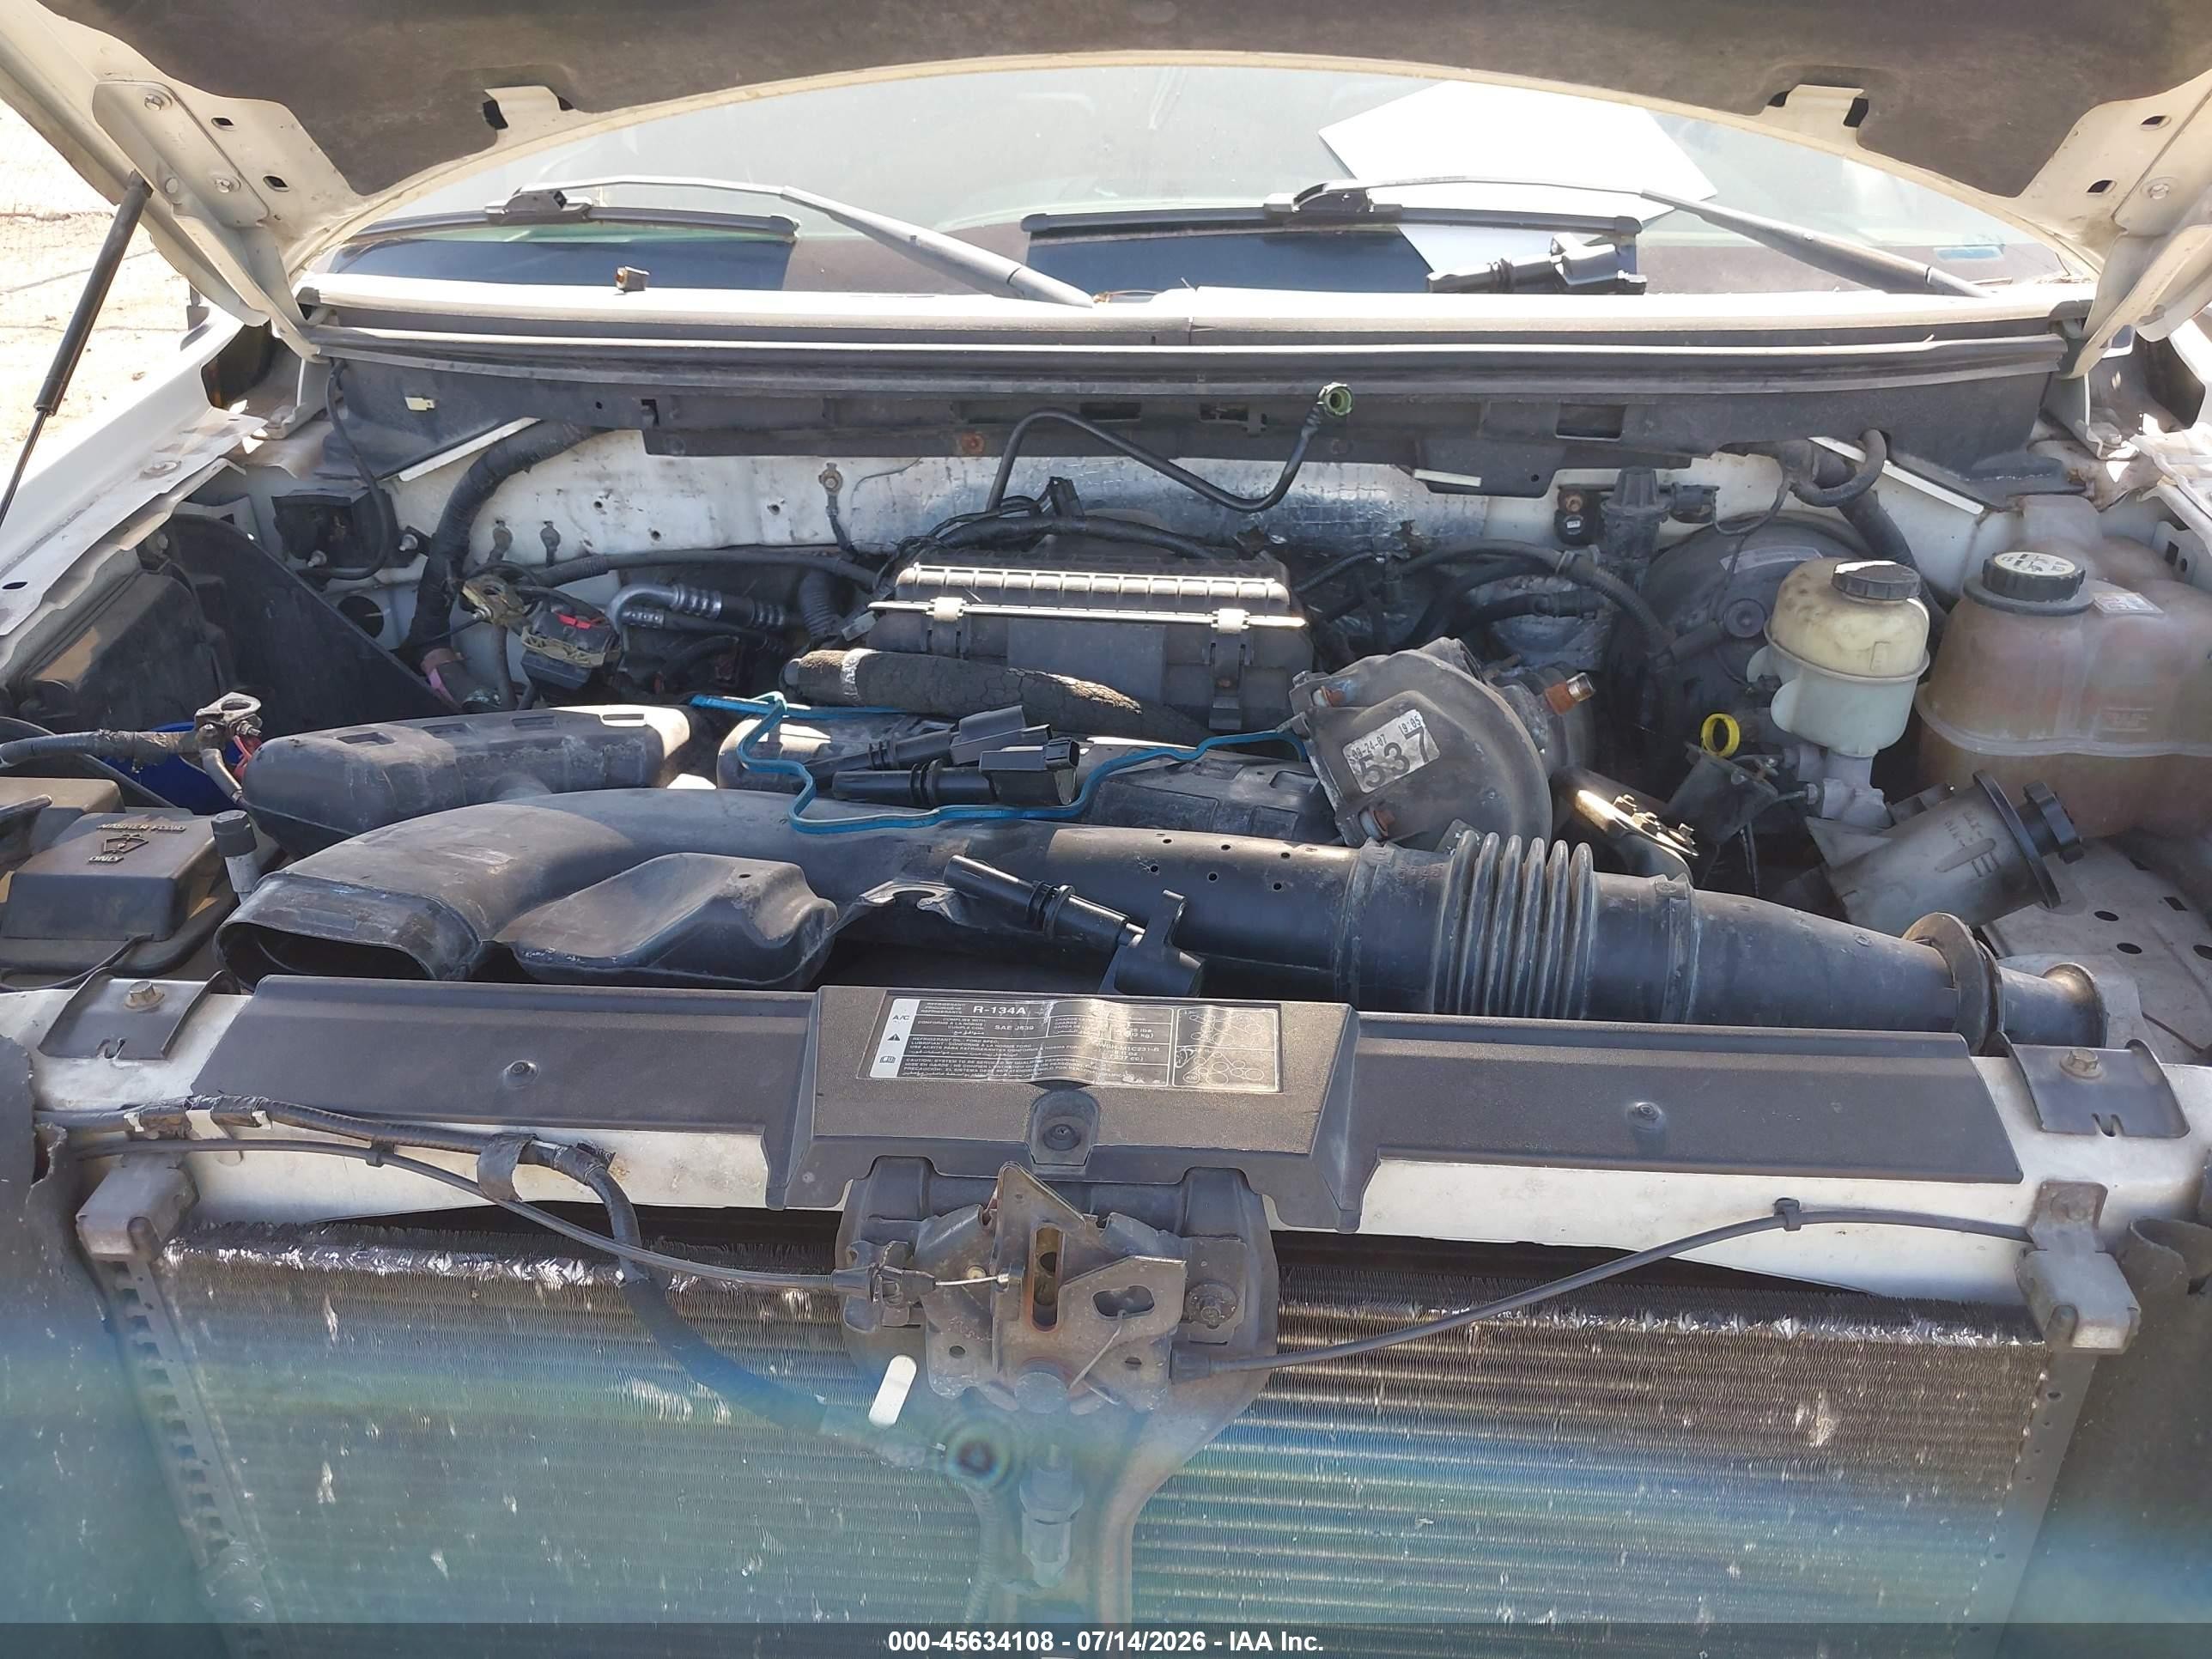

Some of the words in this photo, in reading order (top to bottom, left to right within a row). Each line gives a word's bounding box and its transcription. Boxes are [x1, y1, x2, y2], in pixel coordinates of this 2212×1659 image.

[1398, 715, 1422, 737] 19:05
[1358, 725, 1430, 787] 537
[88, 855, 125, 864] ONLY
[973, 1006, 1027, 1015] R-134A
